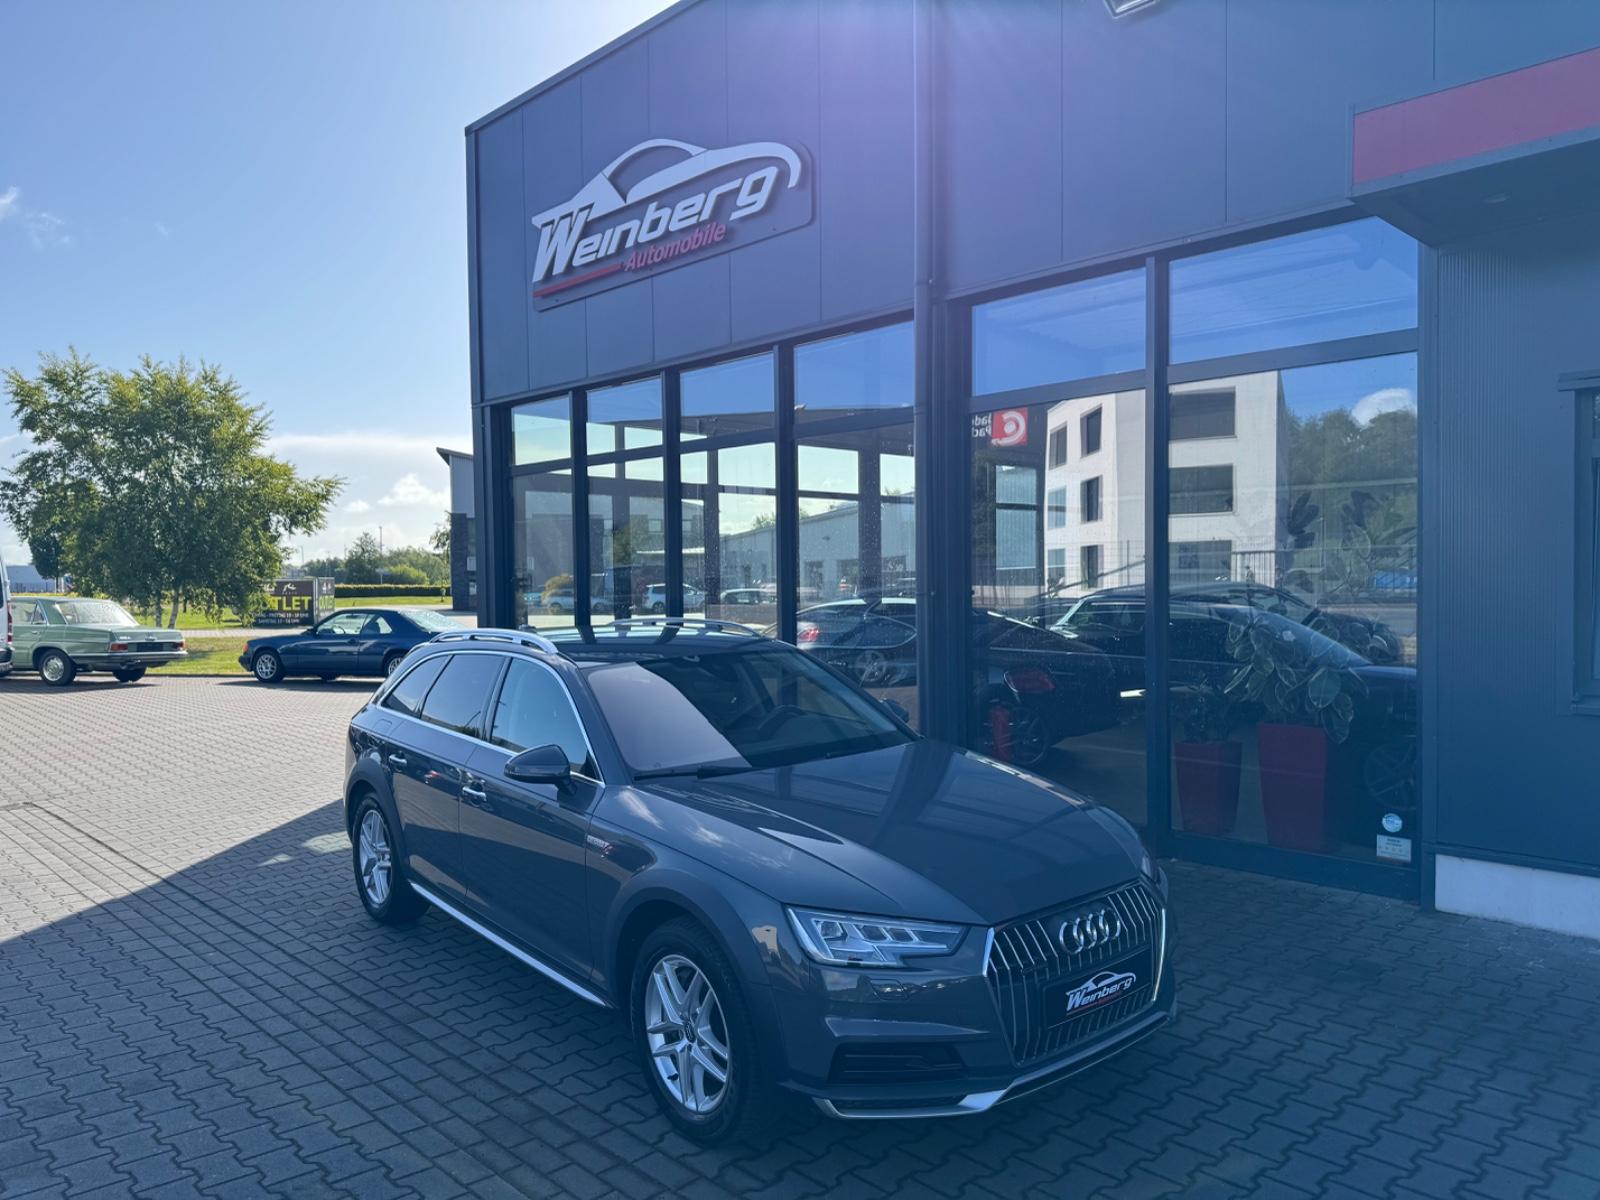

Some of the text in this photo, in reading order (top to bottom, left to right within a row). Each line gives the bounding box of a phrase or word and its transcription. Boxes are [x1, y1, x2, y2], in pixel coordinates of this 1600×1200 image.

[531, 166, 779, 283] Weinberg
[624, 222, 727, 272] Automobile
[269, 595, 312, 611] TLET
[1066, 977, 1132, 1012] Weinberg
